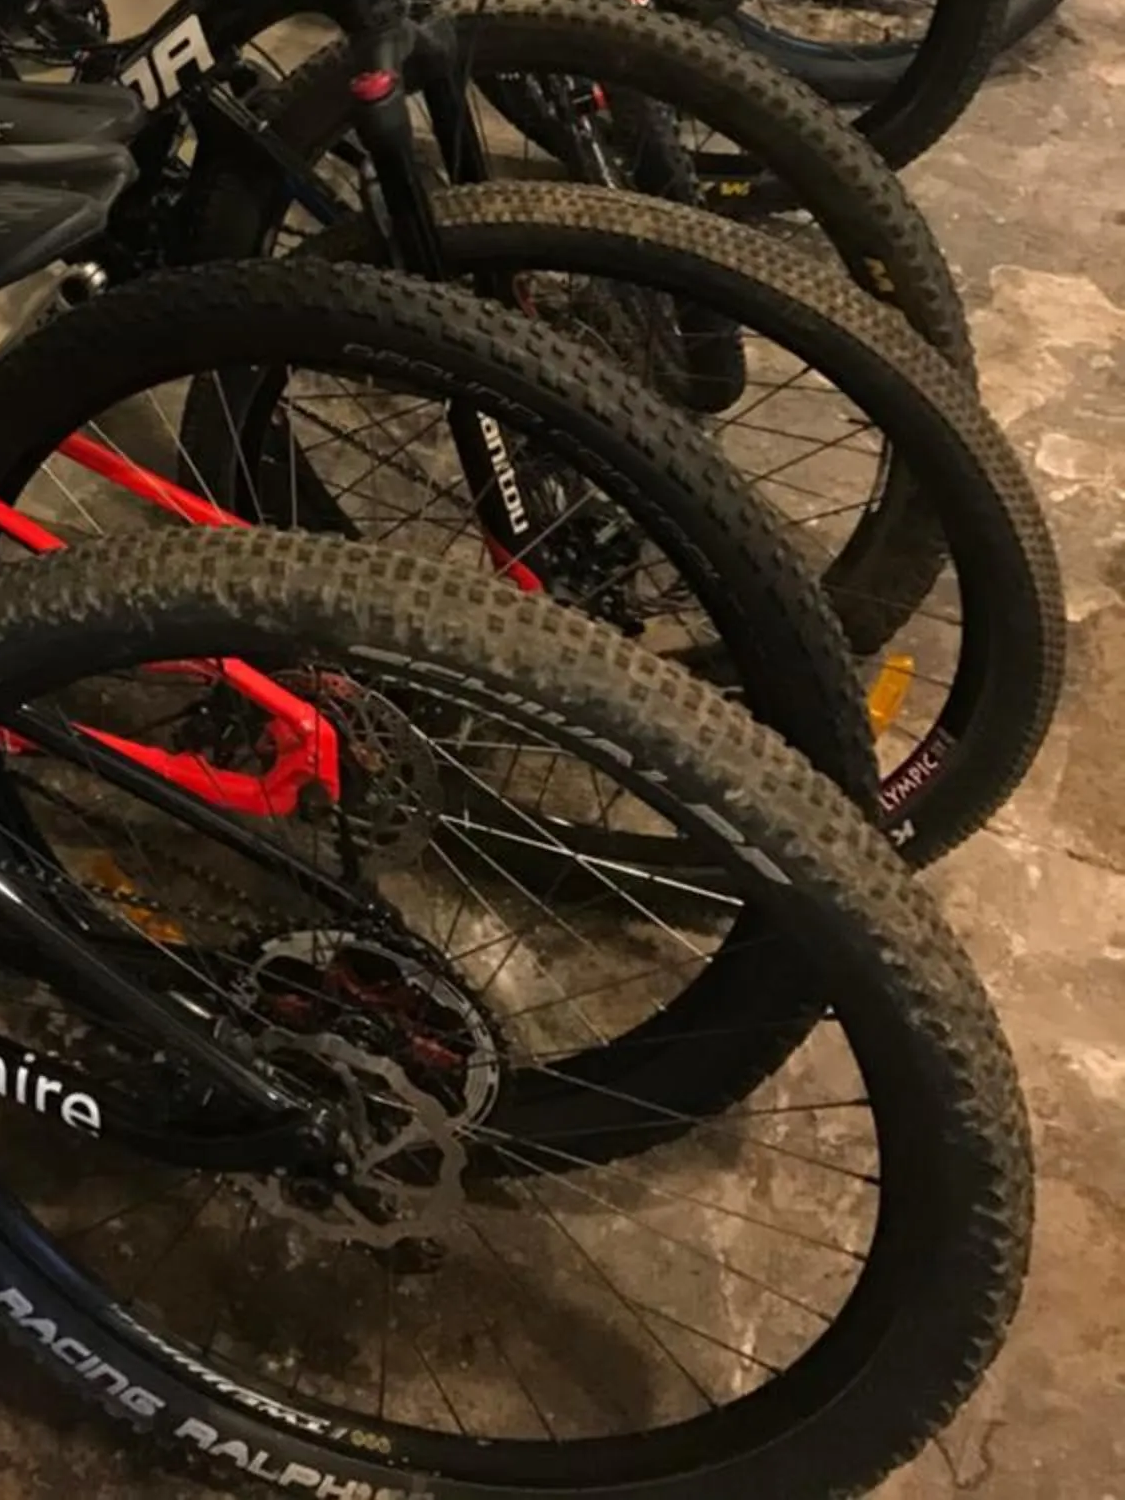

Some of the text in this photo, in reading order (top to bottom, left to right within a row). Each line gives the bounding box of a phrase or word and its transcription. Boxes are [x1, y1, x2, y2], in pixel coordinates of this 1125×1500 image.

[476, 410, 530, 536] anitou
[878, 752, 940, 813] LYMPIC
[174, 1417, 362, 1500] RALPH
